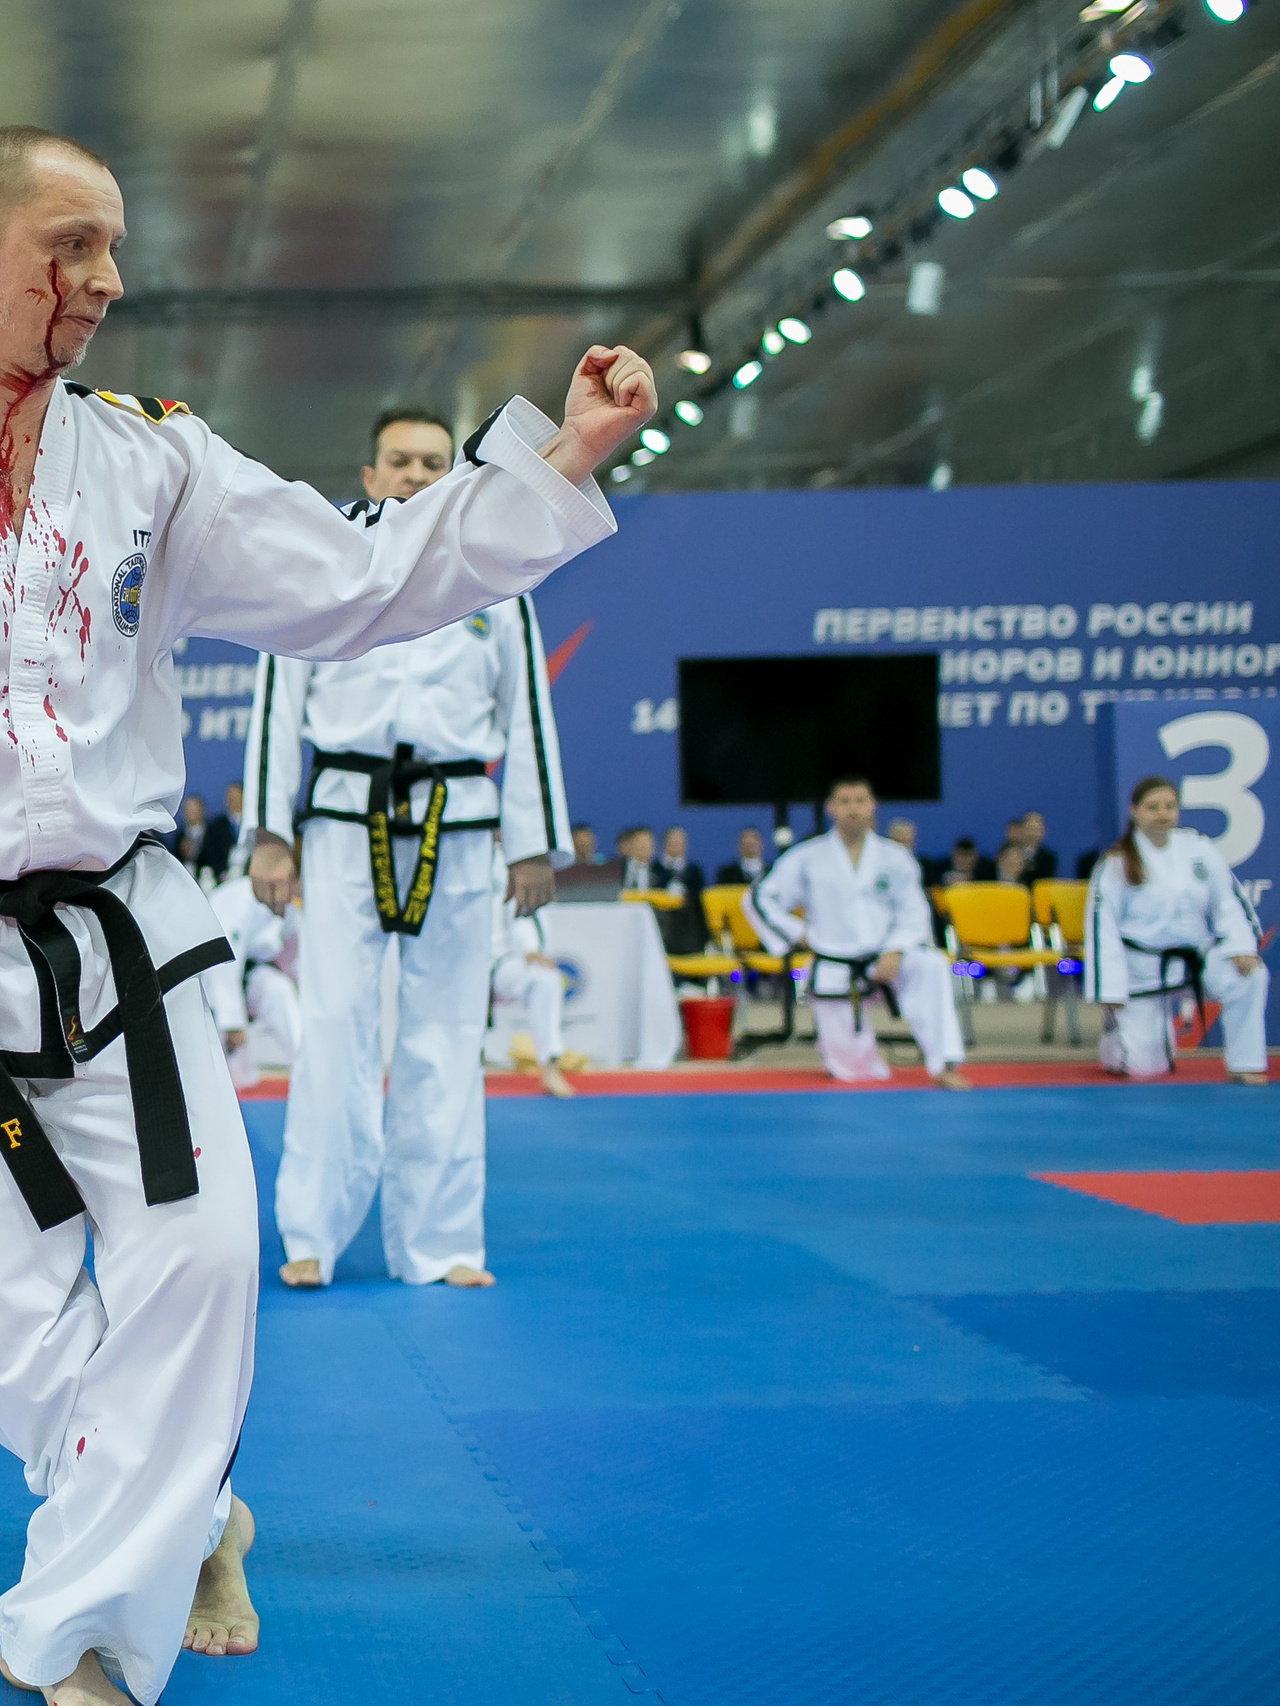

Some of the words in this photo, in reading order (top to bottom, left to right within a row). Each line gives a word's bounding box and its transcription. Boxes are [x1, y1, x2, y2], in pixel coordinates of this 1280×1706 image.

[813, 603, 1078, 643] ПЕРВЕНСТВО
[1086, 601, 1254, 638] РОССИИ
[1091, 646, 1124, 681] И
[1007, 690, 1069, 727] ПО
[1157, 710, 1270, 869] 3
